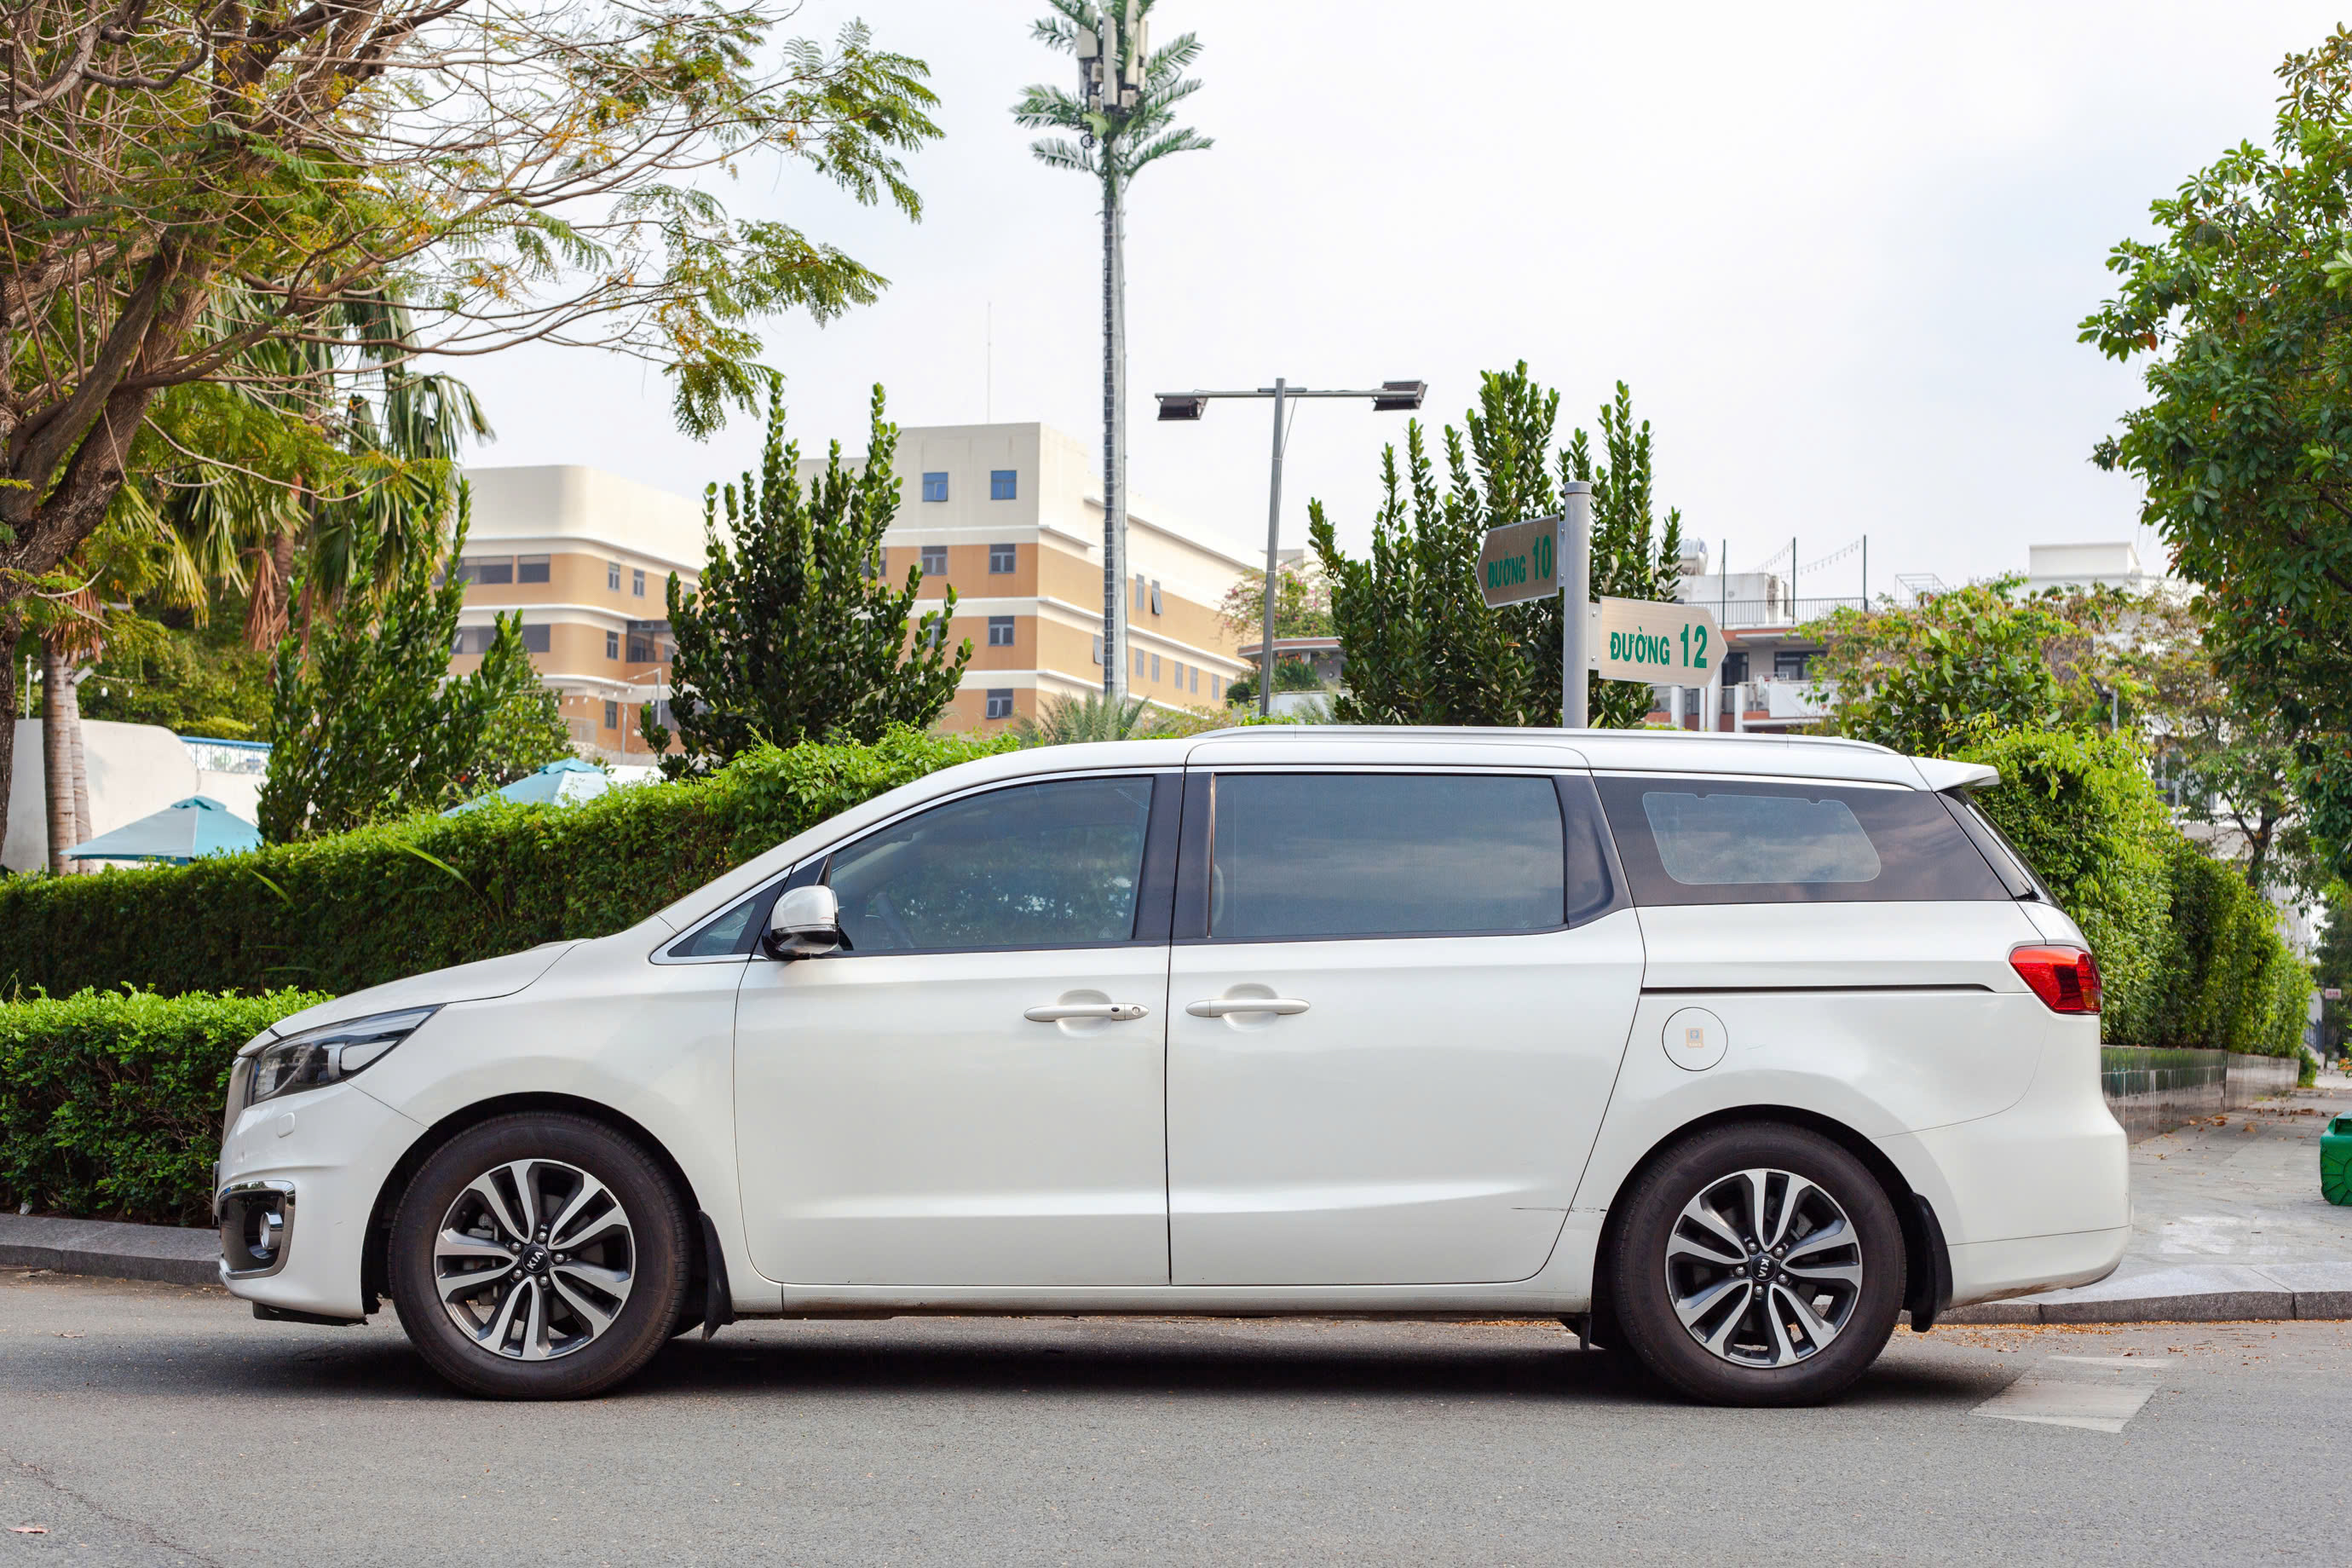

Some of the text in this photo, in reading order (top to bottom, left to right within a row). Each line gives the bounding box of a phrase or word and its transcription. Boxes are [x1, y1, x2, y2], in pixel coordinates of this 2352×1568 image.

[1488, 534, 1552, 589] ĐƯỜNG 10
[1610, 624, 1708, 669] ĐƯỜNG 12
[527, 1251, 544, 1269] KIA
[1758, 1258, 1769, 1277] KIA
